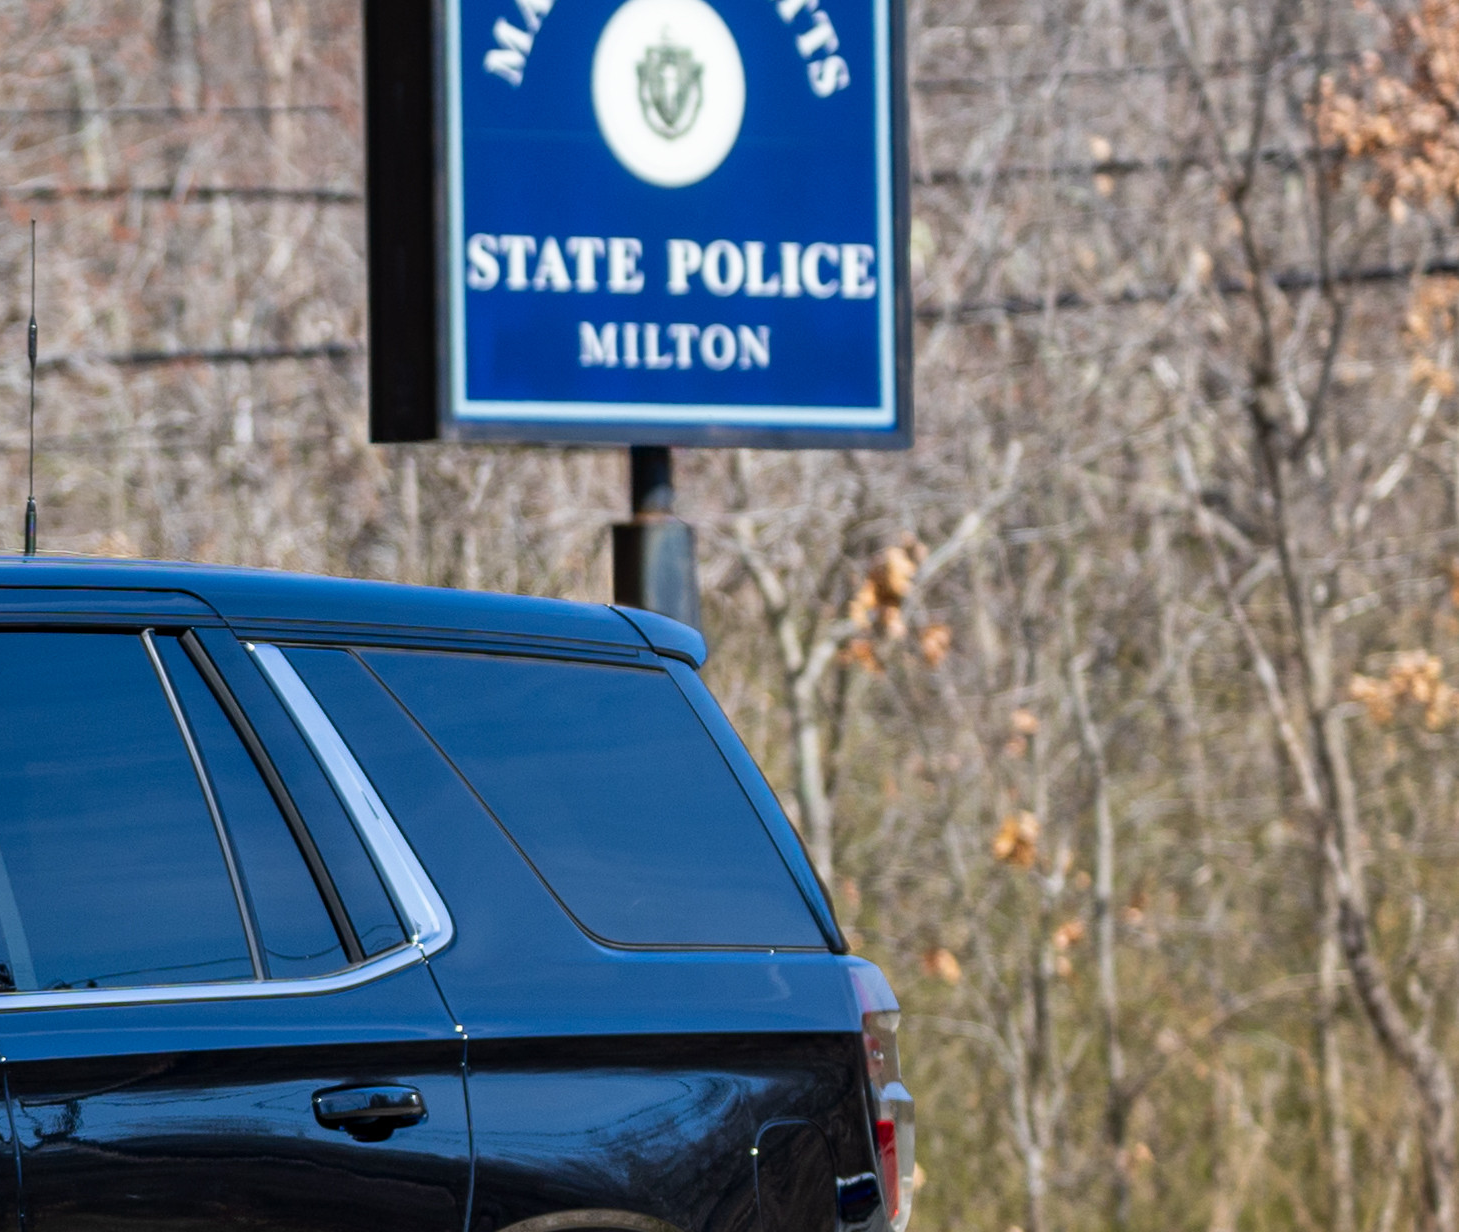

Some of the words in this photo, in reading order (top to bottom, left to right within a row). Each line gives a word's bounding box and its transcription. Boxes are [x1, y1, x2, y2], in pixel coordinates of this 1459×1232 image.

[467, 233, 644, 294] STATE
[667, 239, 877, 299] POLICE
[579, 321, 771, 370] MILTON
